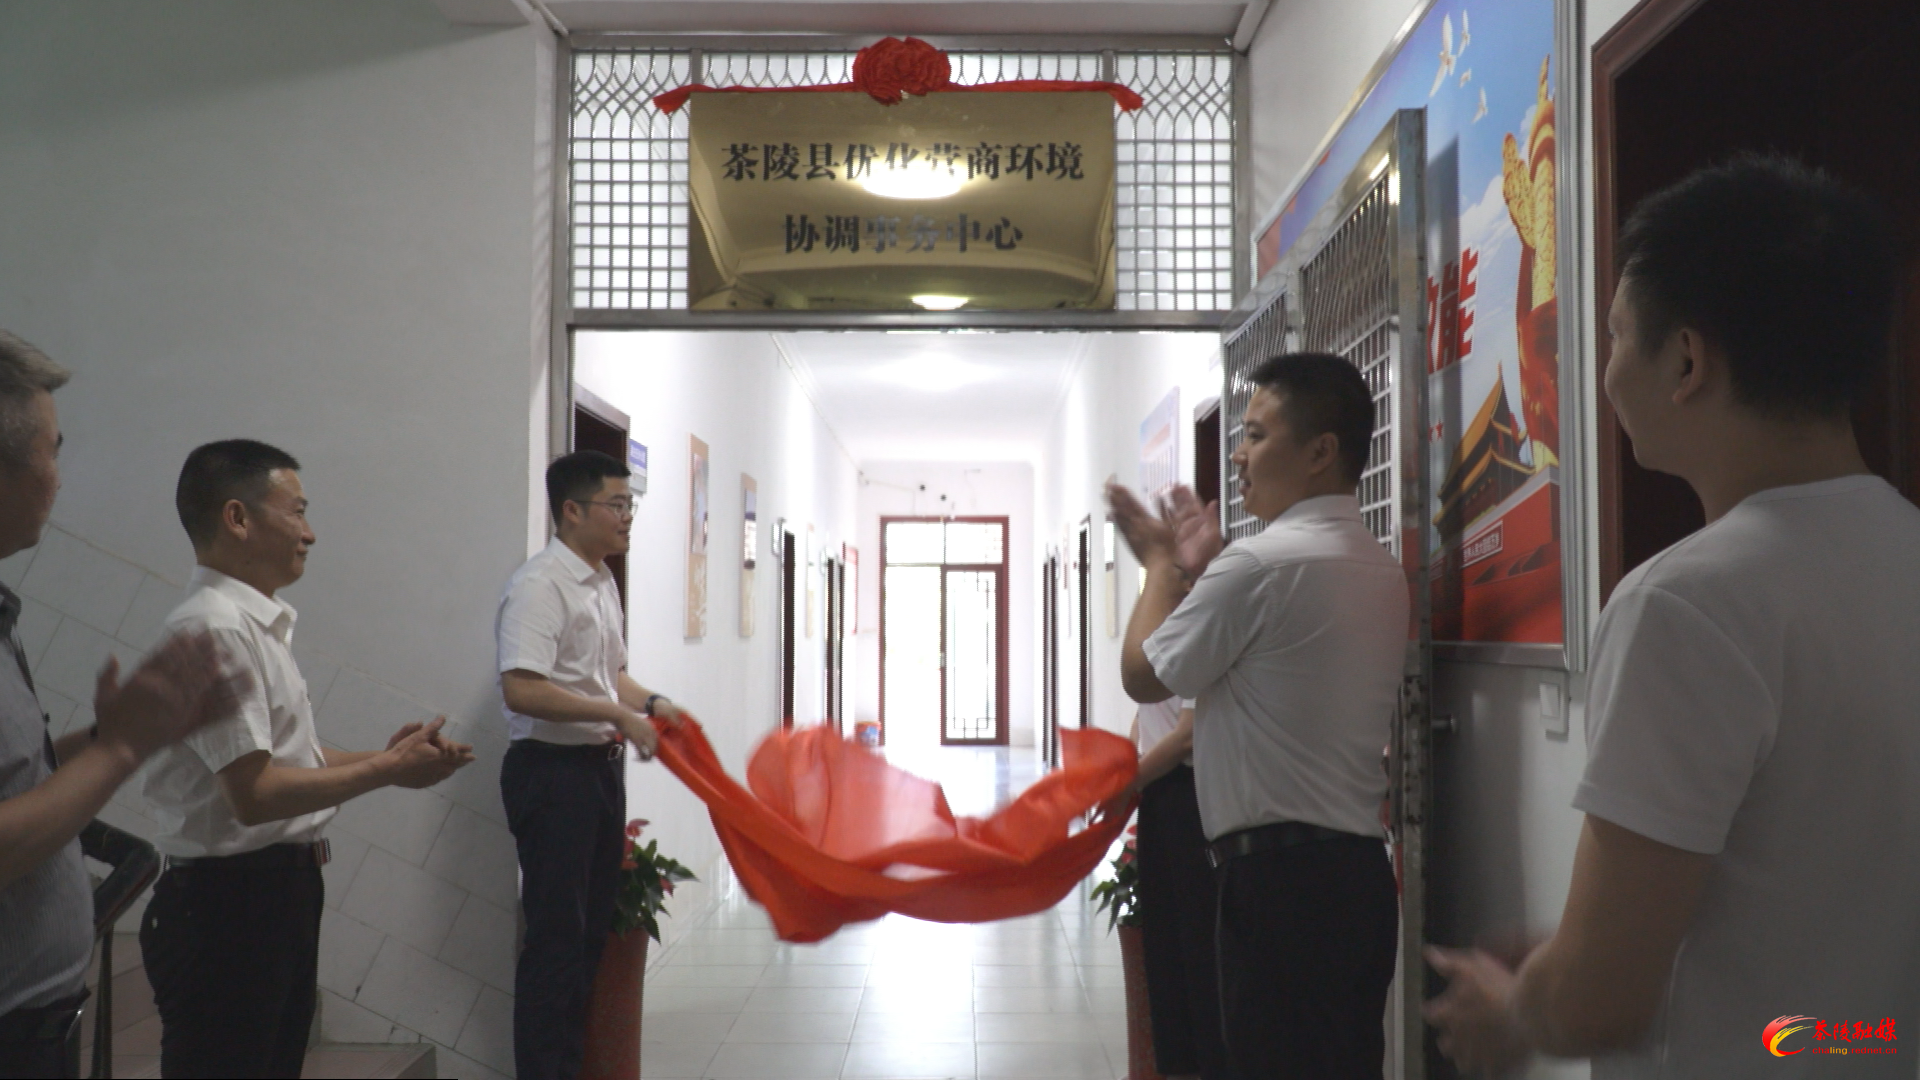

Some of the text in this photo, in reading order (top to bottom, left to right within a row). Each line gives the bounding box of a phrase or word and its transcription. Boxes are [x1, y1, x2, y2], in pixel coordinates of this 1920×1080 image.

[783, 213, 1023, 254] 协调事务中心
